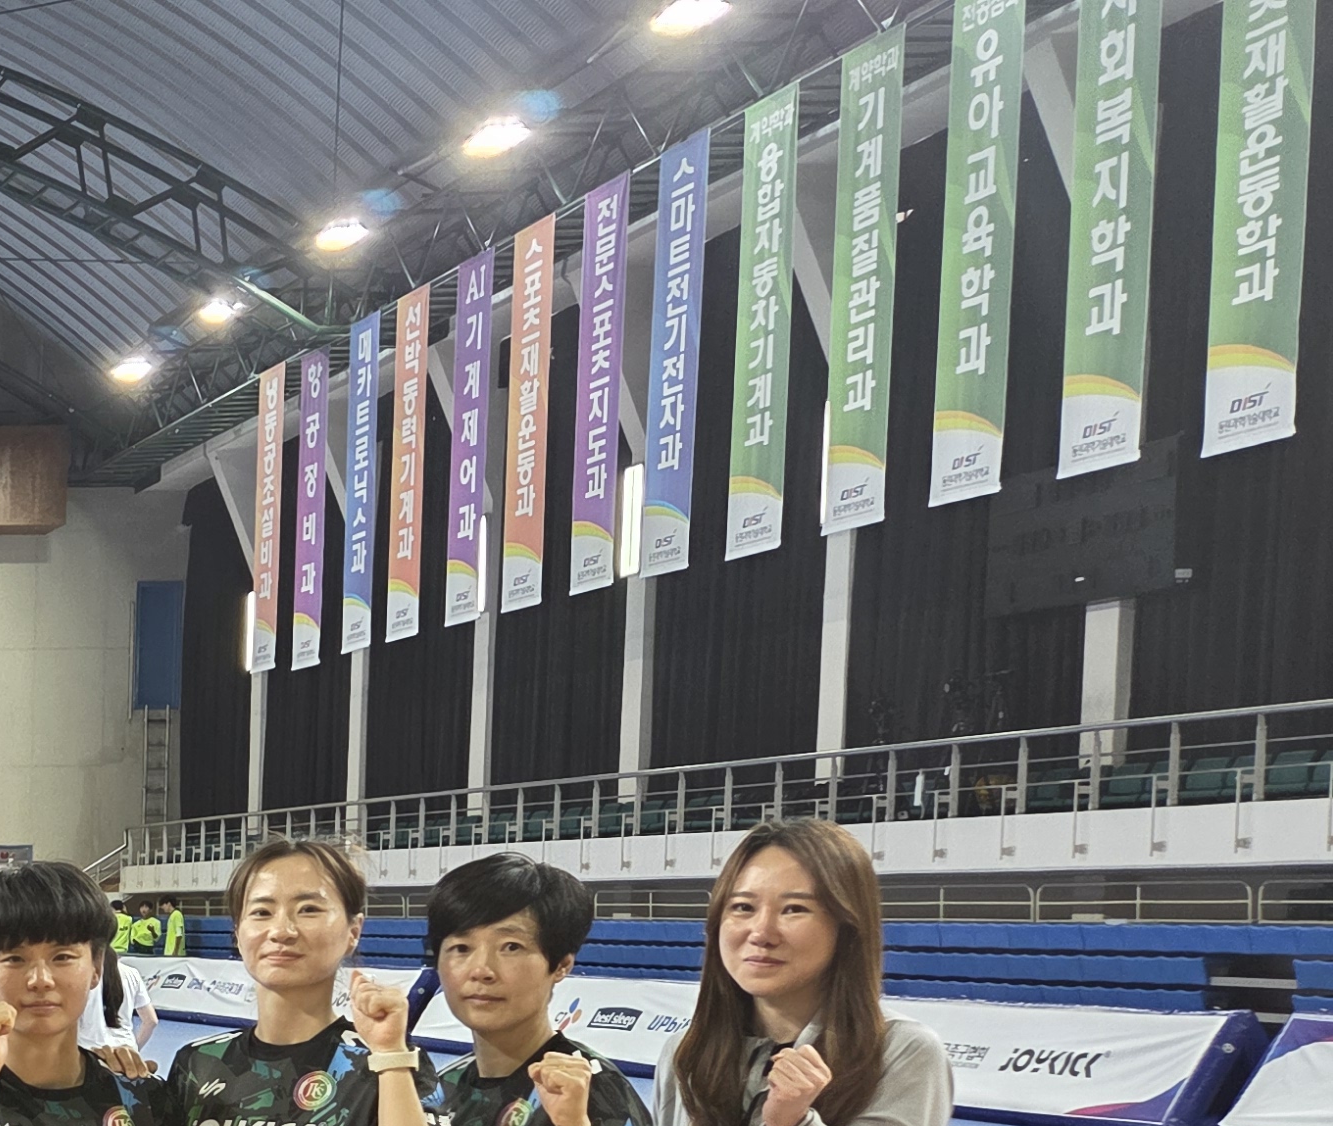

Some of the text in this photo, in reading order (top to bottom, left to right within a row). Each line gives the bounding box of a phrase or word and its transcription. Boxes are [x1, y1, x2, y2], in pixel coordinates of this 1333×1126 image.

[749, 102, 796, 145] 계약학과
[848, 44, 900, 92] 계약학과
[657, 157, 695, 470] 스마트전기전자과
[744, 143, 784, 446] 융합자동차기계과
[843, 87, 886, 412] 기계품질관리과
[955, 29, 1004, 374] 유아교육학과
[351, 328, 373, 573] 메카트로닉스과
[397, 302, 421, 559] 선박동력기계과
[515, 238, 543, 516] 스포츠재활운동과
[584, 194, 618, 499] 전문스포츠지도과
[1081, 420, 1116, 438] DIST
[1229, 393, 1266, 413] DIST
[258, 377, 279, 600] 냉동공조설비과
[300, 361, 323, 594] 항공정비과
[742, 512, 766, 528] DIST
[840, 483, 867, 500] DIST
[951, 452, 980, 470] DIST
[593, 1011, 636, 1028] best sleep
